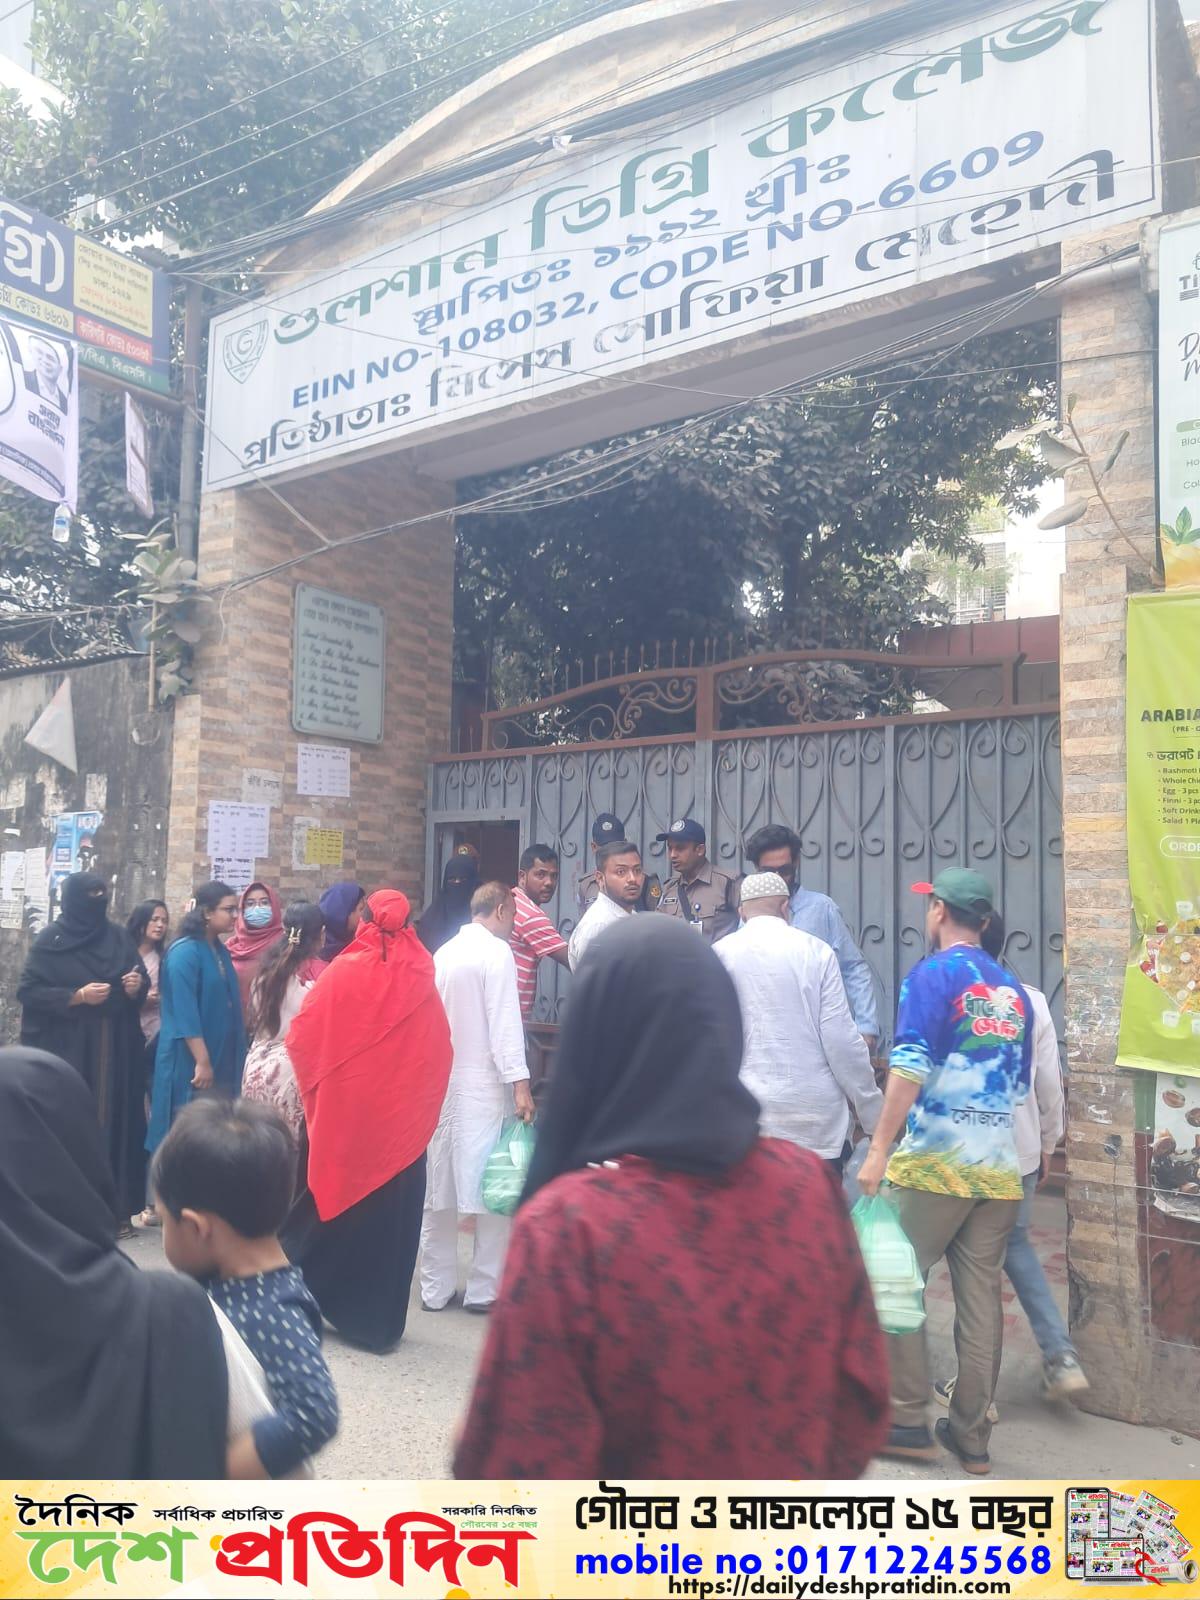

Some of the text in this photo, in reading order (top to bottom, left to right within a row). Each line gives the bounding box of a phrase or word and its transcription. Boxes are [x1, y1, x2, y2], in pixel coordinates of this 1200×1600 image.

[274, 0, 1107, 344] গুলশান ডিগ্রি কলেজ
[293, 131, 1043, 408] EIIN NO-108032, CODE NO-6609
[594, 208, 720, 267] ১৯৯২
[1178, 332, 1200, 362] D
[241, 394, 411, 469] প্রতিষ্ঠাতাঃ
[1162, 787, 1176, 795] Egg
